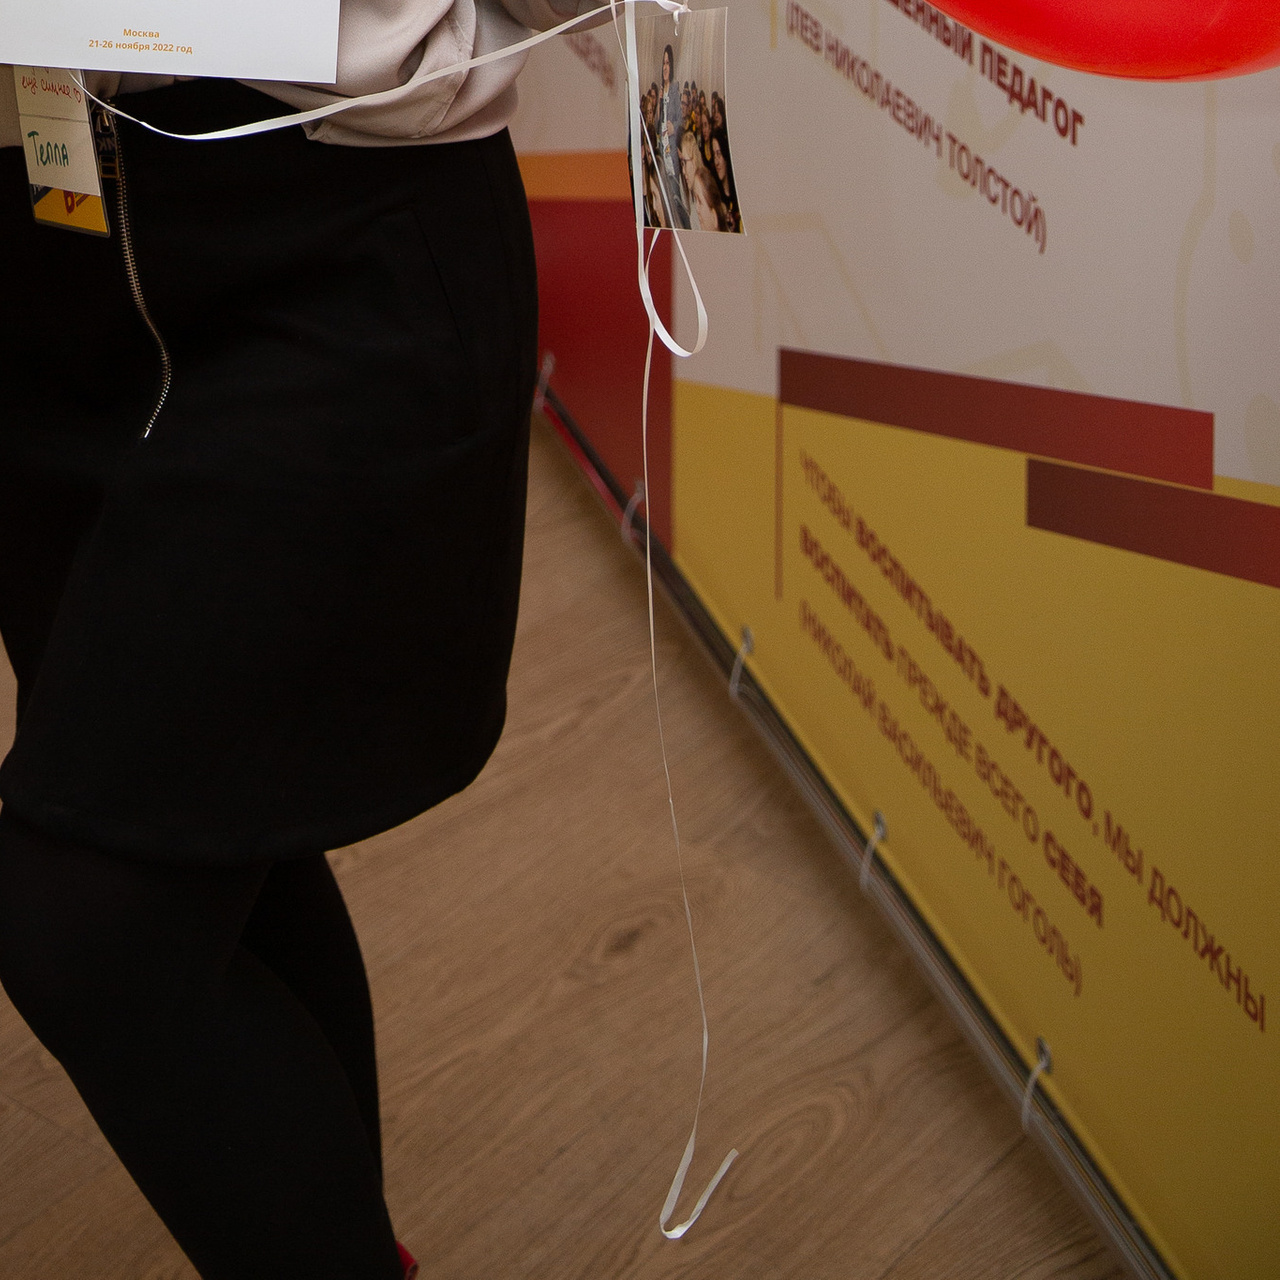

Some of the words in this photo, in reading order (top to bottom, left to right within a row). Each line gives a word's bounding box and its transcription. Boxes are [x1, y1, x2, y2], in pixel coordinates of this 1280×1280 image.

[89, 40, 113, 49] 21-26
[115, 42, 150, 52] ноября
[152, 43, 174, 52] 2022
[176, 45, 192, 55] год
[123, 28, 160, 39] Москва
[979, 42, 1085, 147] ПЕДАГОГ
[823, 30, 943, 160] НИКОЛАЕВИЧ
[947, 131, 1047, 255] ТОЛСТОЙ)
[799, 524, 894, 661] ВОСПИТАТЬ
[897, 645, 973, 763] ПРЕЖДЕ
[975, 742, 1040, 843] ВСЕГО
[1043, 830, 1104, 928] СЕБЯ
[855, 516, 990, 698] ВОСПИТЫВАТЬ
[994, 685, 1100, 837] ДРУГОГО,
[1104, 809, 1144, 885] МЫ
[1148, 866, 1266, 1033] ДОЛЖНЫ
[997, 857, 1083, 998] ГОГОЛЬ)
